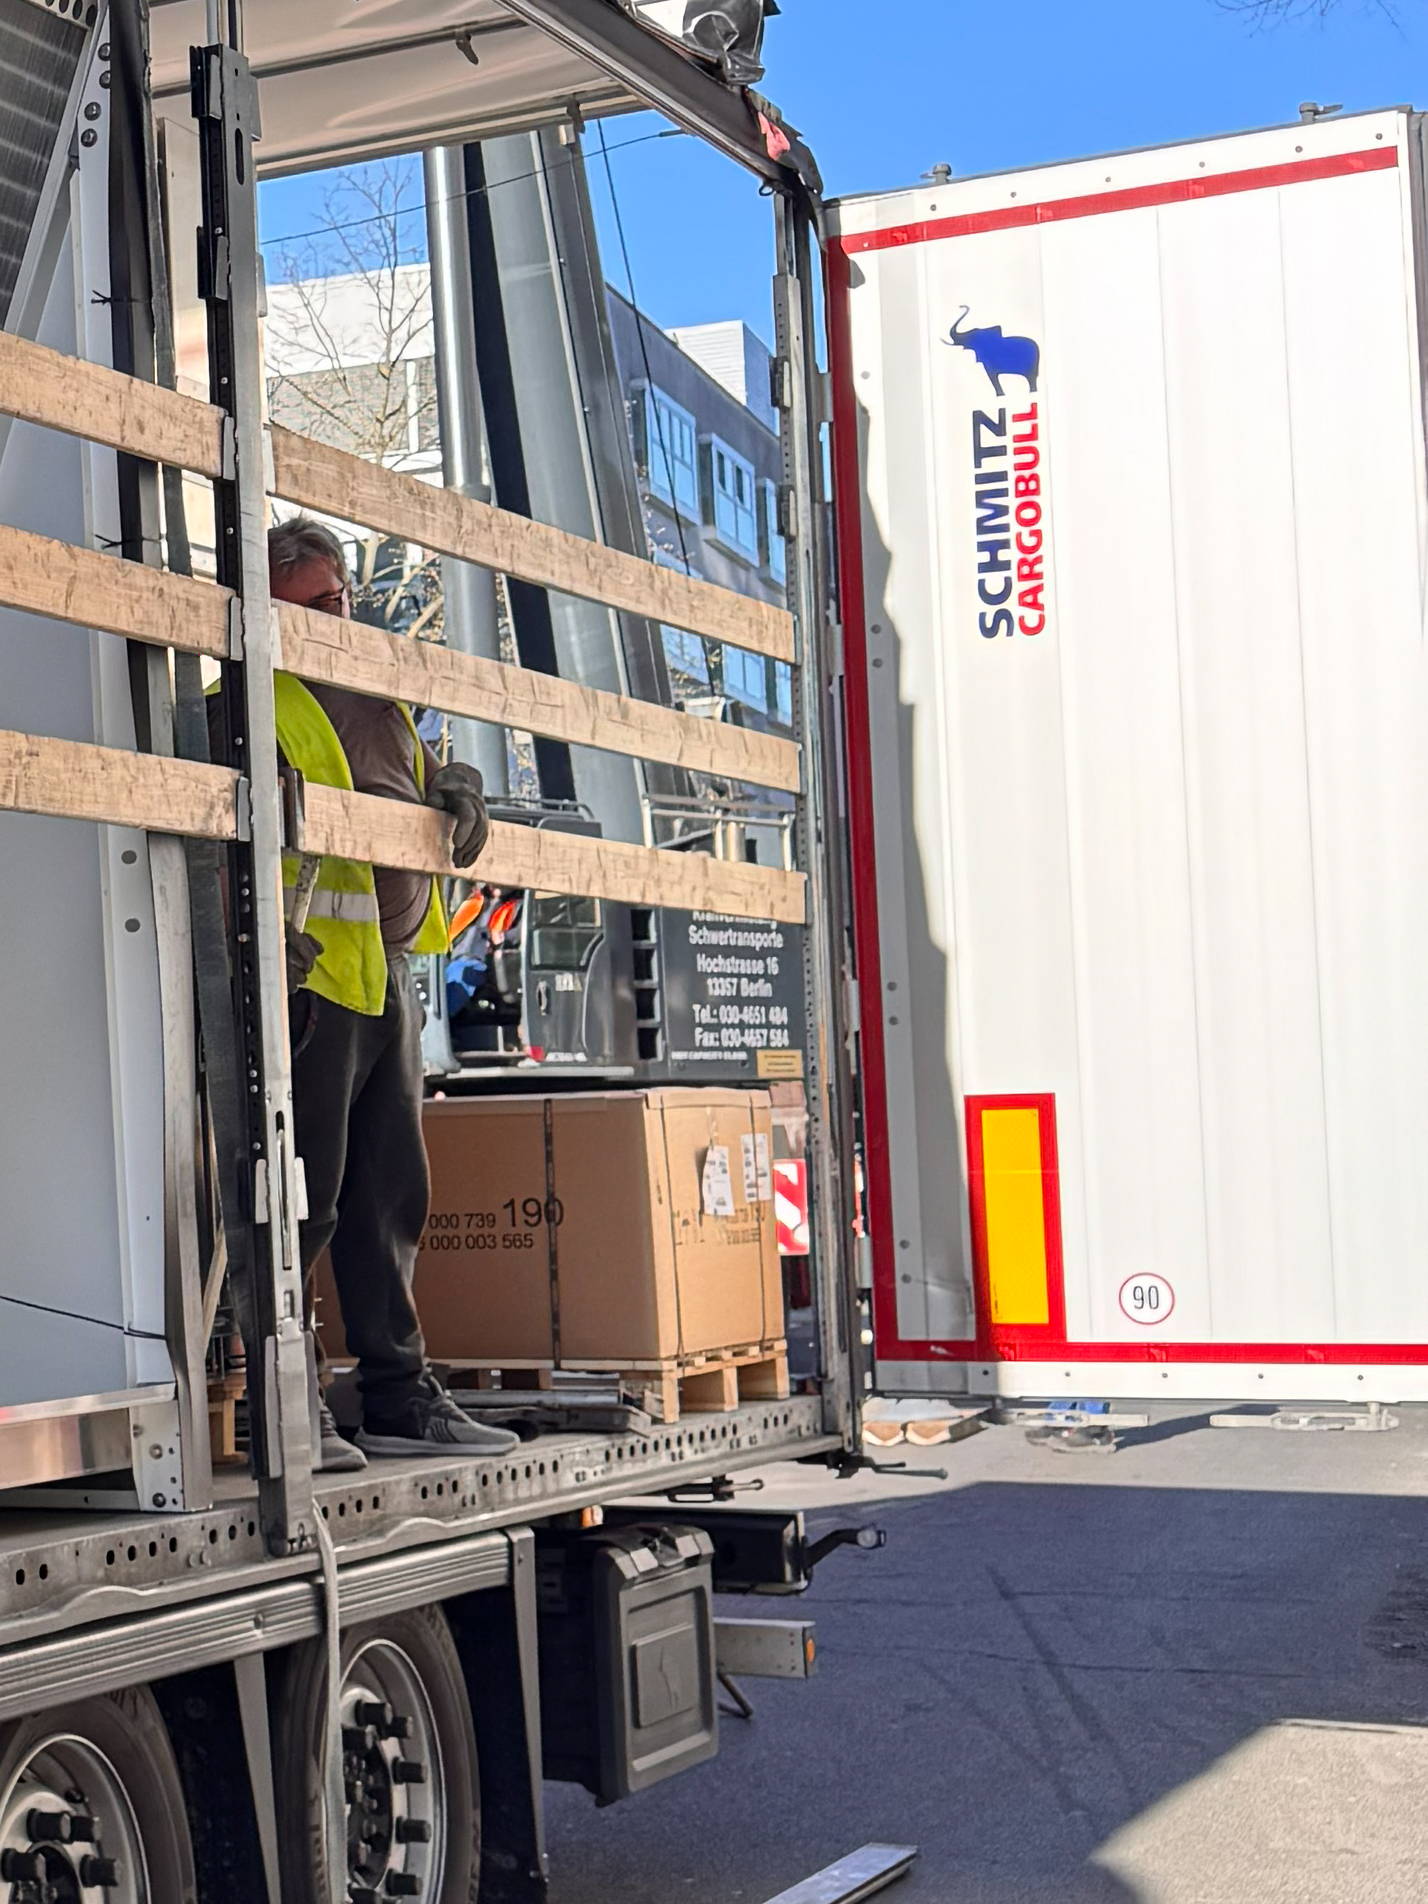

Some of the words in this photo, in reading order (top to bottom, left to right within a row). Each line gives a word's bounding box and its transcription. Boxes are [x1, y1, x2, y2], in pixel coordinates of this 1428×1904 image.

[972, 407, 1014, 639] SCHMITZ
[1012, 402, 1046, 637] CARGOBULL
[696, 953, 765, 974] Hochstrasse
[740, 978, 773, 998] Berlin
[503, 1197, 564, 1227] 190
[1133, 1285, 1160, 1310] 90
